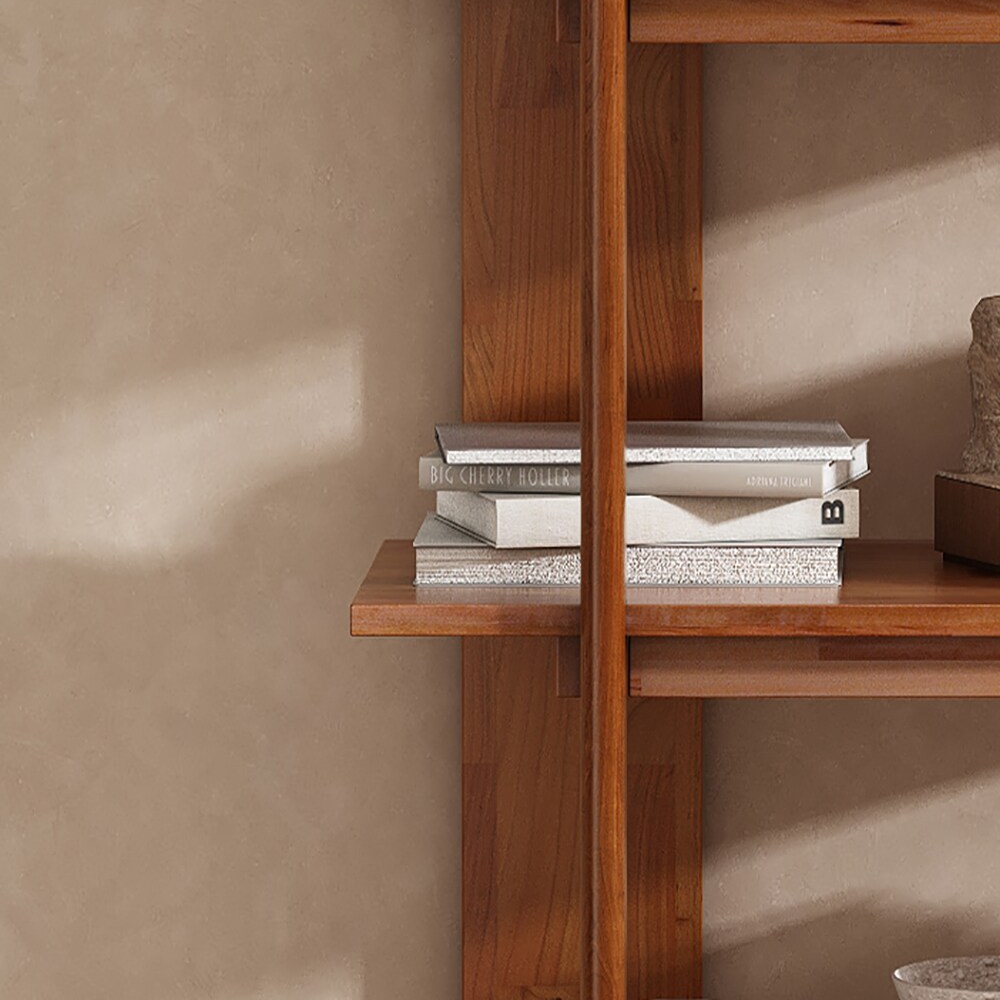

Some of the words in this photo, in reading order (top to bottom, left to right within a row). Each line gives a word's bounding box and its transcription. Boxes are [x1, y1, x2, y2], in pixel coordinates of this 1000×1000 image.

[430, 465, 453, 485] BIG
[459, 465, 513, 486] CHERRY
[519, 467, 570, 487] HOLLER
[821, 499, 844, 525] B
